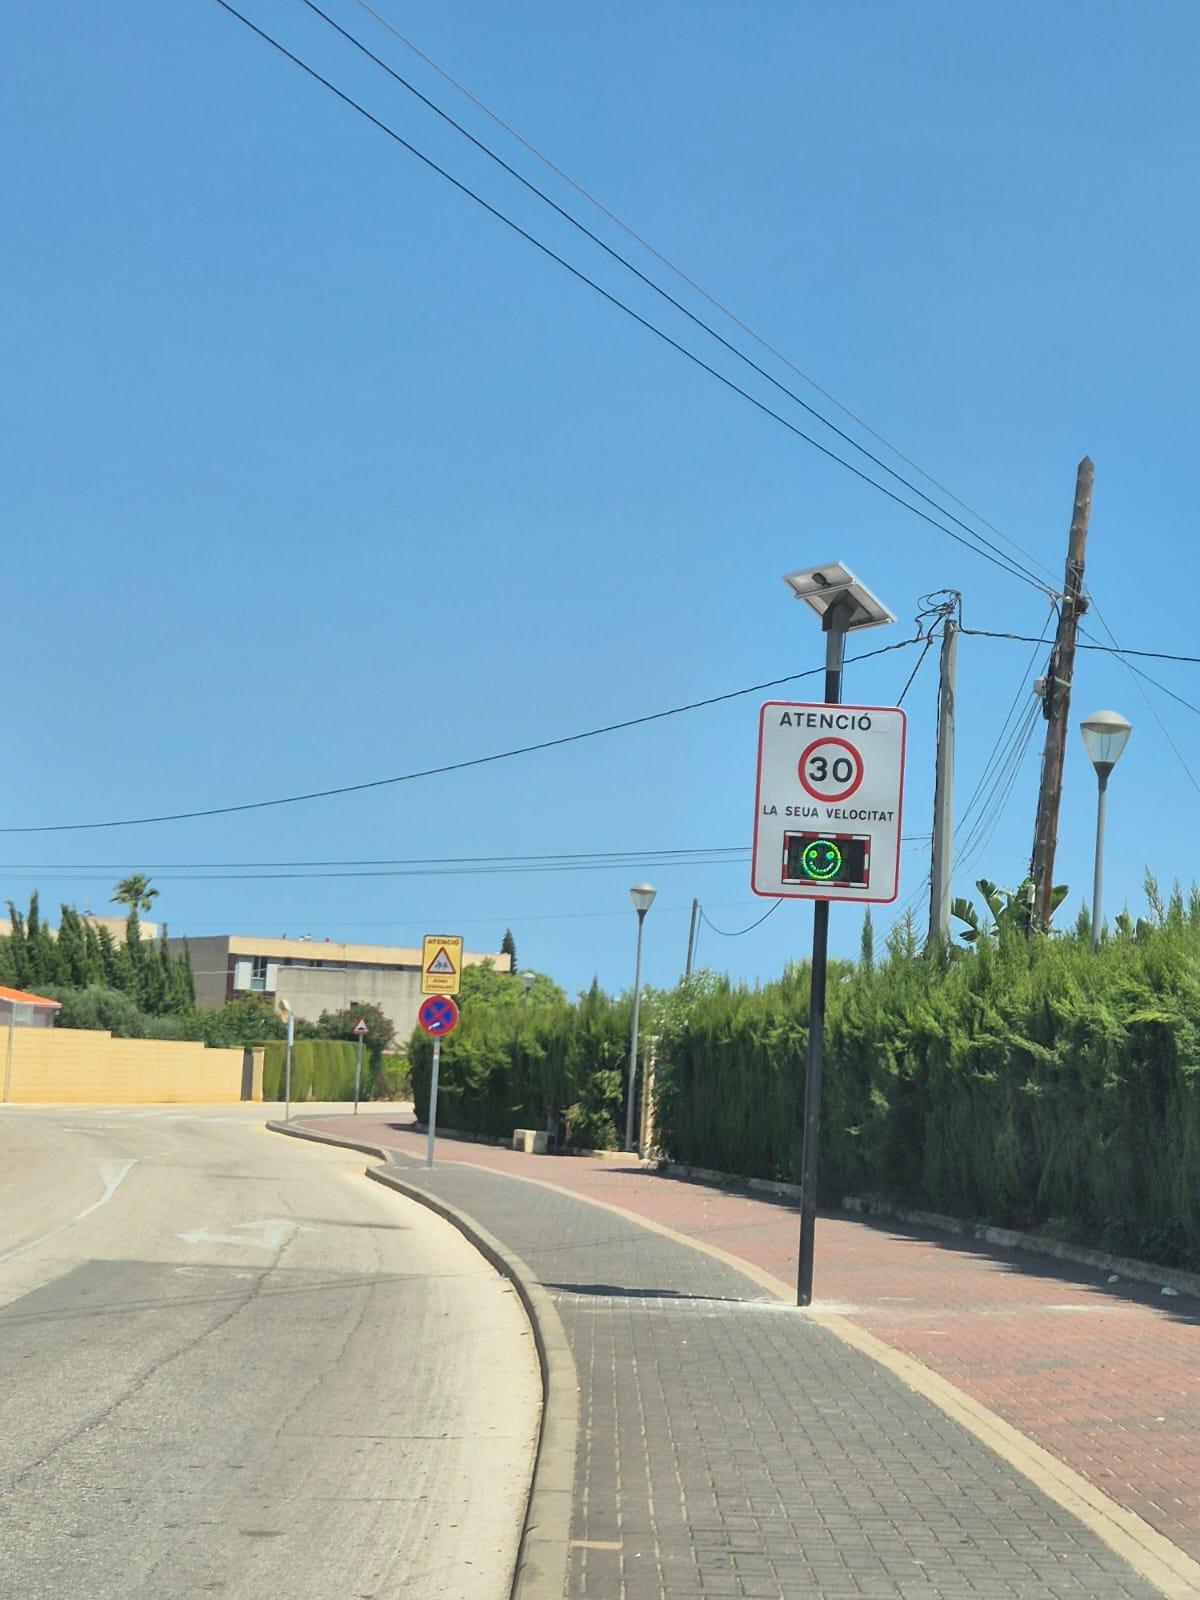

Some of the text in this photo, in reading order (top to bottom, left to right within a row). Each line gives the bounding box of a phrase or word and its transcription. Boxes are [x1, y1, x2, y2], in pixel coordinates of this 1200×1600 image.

[779, 711, 872, 731] ATENCIÓ
[808, 756, 853, 783] 30
[763, 804, 894, 822] LA SEUA VELOCITAT
